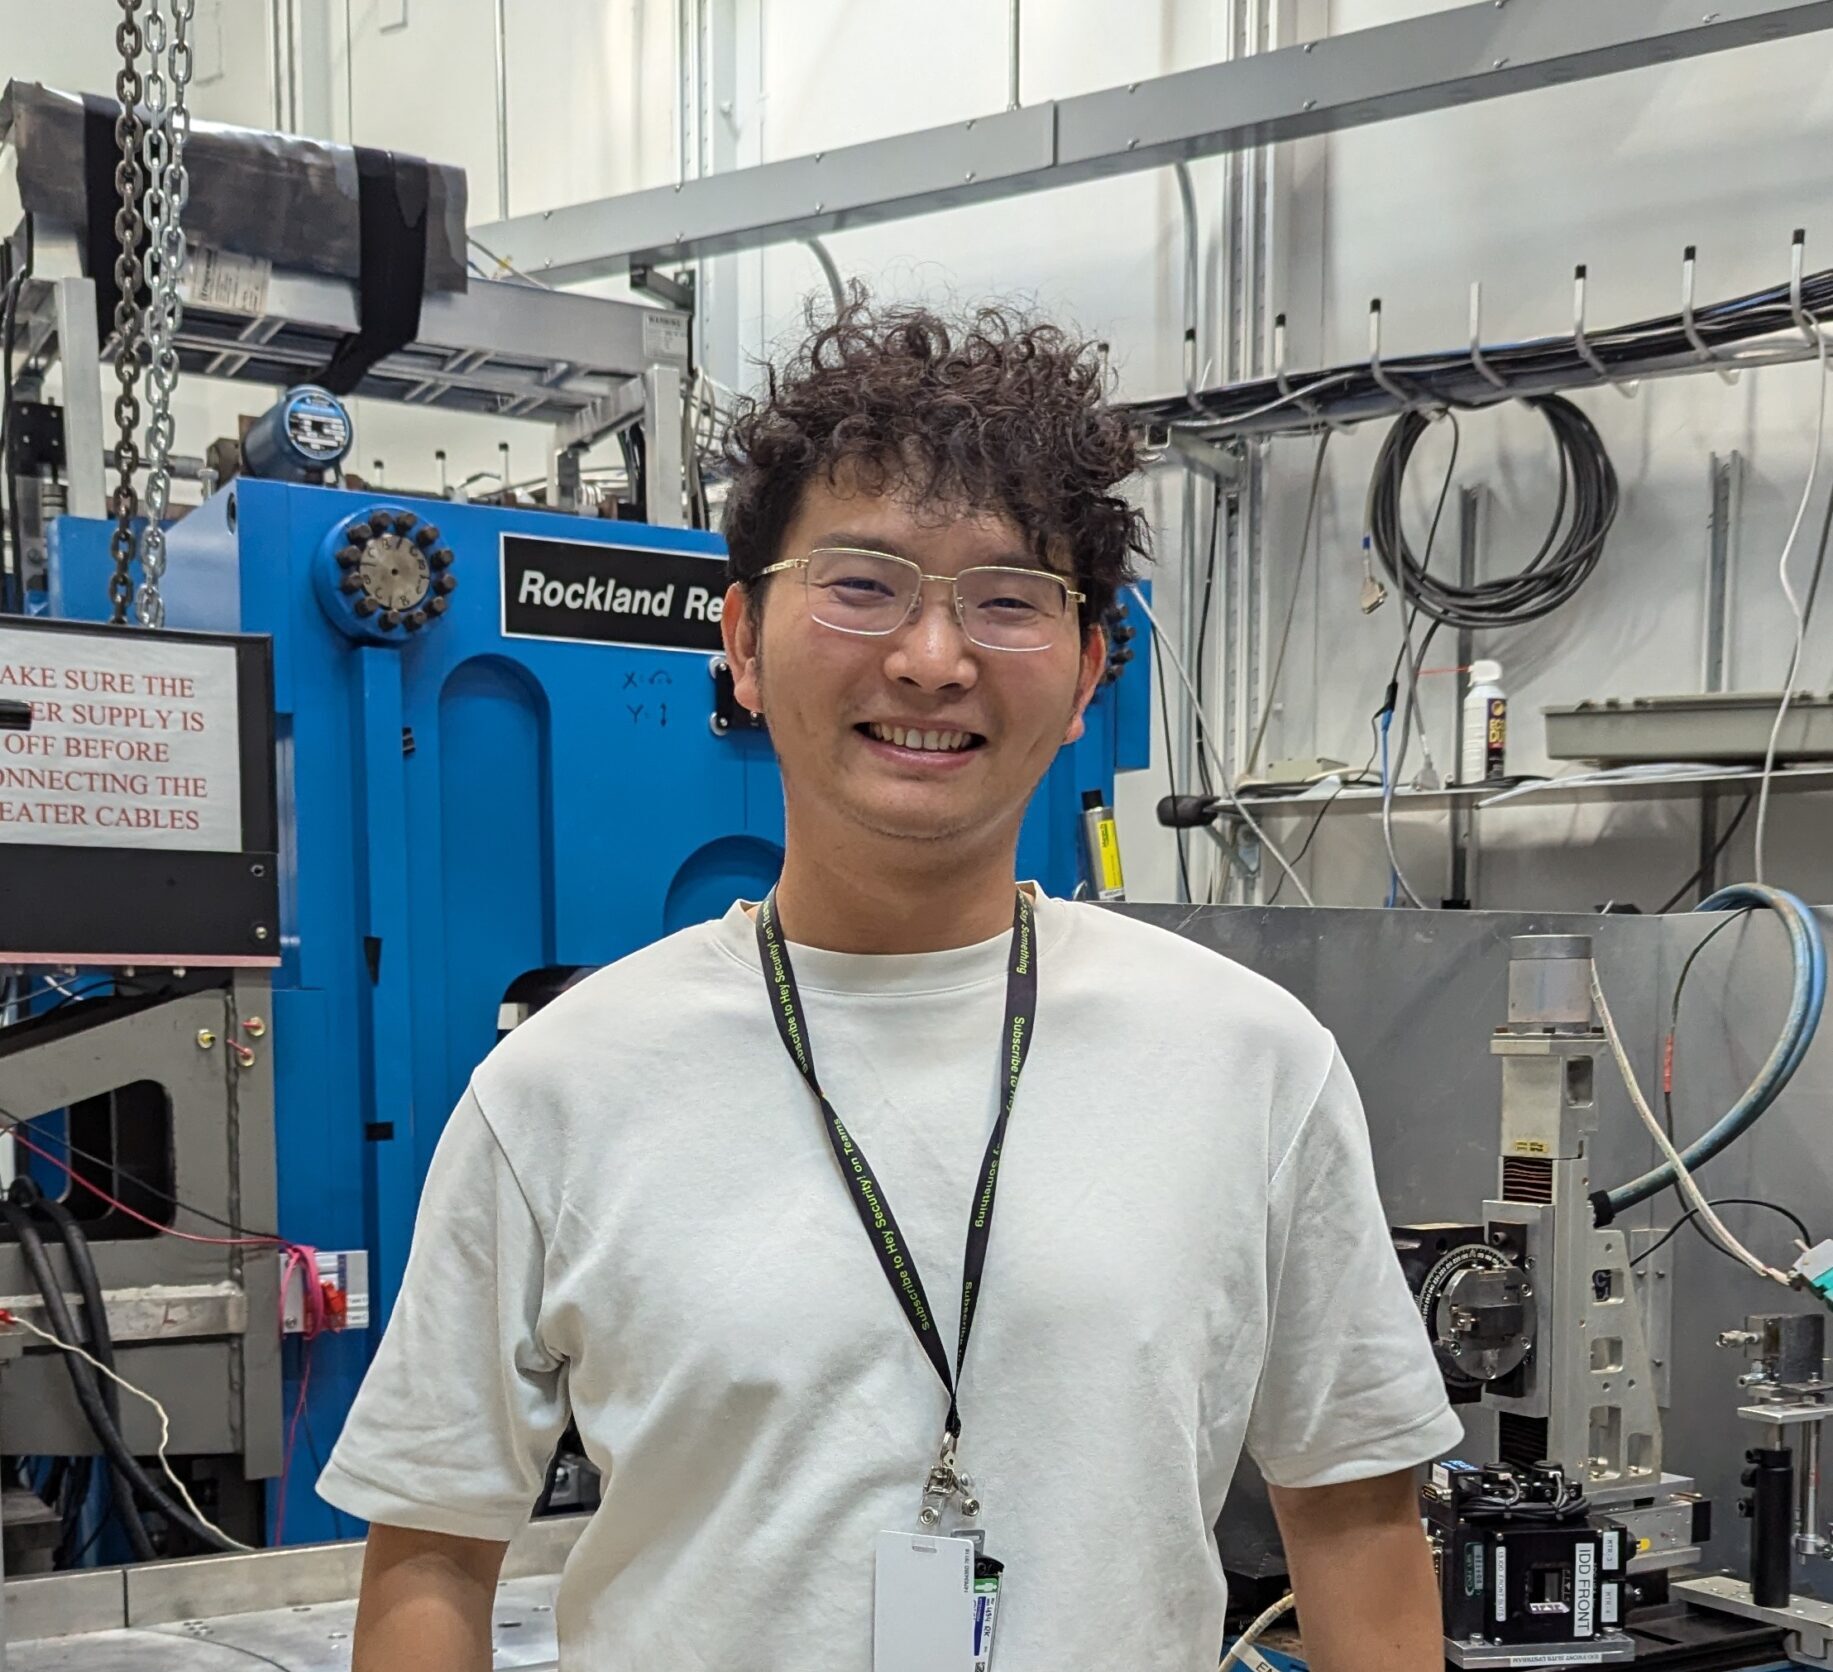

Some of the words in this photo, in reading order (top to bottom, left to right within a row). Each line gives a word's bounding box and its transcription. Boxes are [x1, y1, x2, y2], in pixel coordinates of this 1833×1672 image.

[518, 569, 675, 617] Rockland
[64, 669, 135, 694] SURE
[142, 675, 195, 698] THE
[30, 701, 64, 722] ER
[72, 704, 173, 729] SUPPLY
[181, 711, 205, 731] IS
[4, 733, 57, 755] OFF
[65, 737, 170, 762] BEFORE
[0, 767, 148, 795] NNECTING
[156, 776, 208, 797] THE
[95, 806, 199, 830] CABLES
[766, 928, 775, 940] on
[767, 940, 786, 983] Security!
[1016, 924, 1030, 975] Something
[779, 984, 790, 1004] Hey
[784, 1004, 795, 1017] to
[788, 1017, 810, 1074] Subscribe
[1010, 1016, 1025, 1073] Subscribe
[833, 1118, 854, 1156] Teams
[851, 1157, 864, 1173] on
[856, 1176, 887, 1229] Security!
[974, 1160, 999, 1228] Something
[882, 1230, 898, 1255] Hey
[894, 1255, 905, 1270] to
[899, 1270, 930, 1331] Subscribe
[1578, 1549, 1591, 1575] IDD
[1577, 1579, 1591, 1631] FRONT
